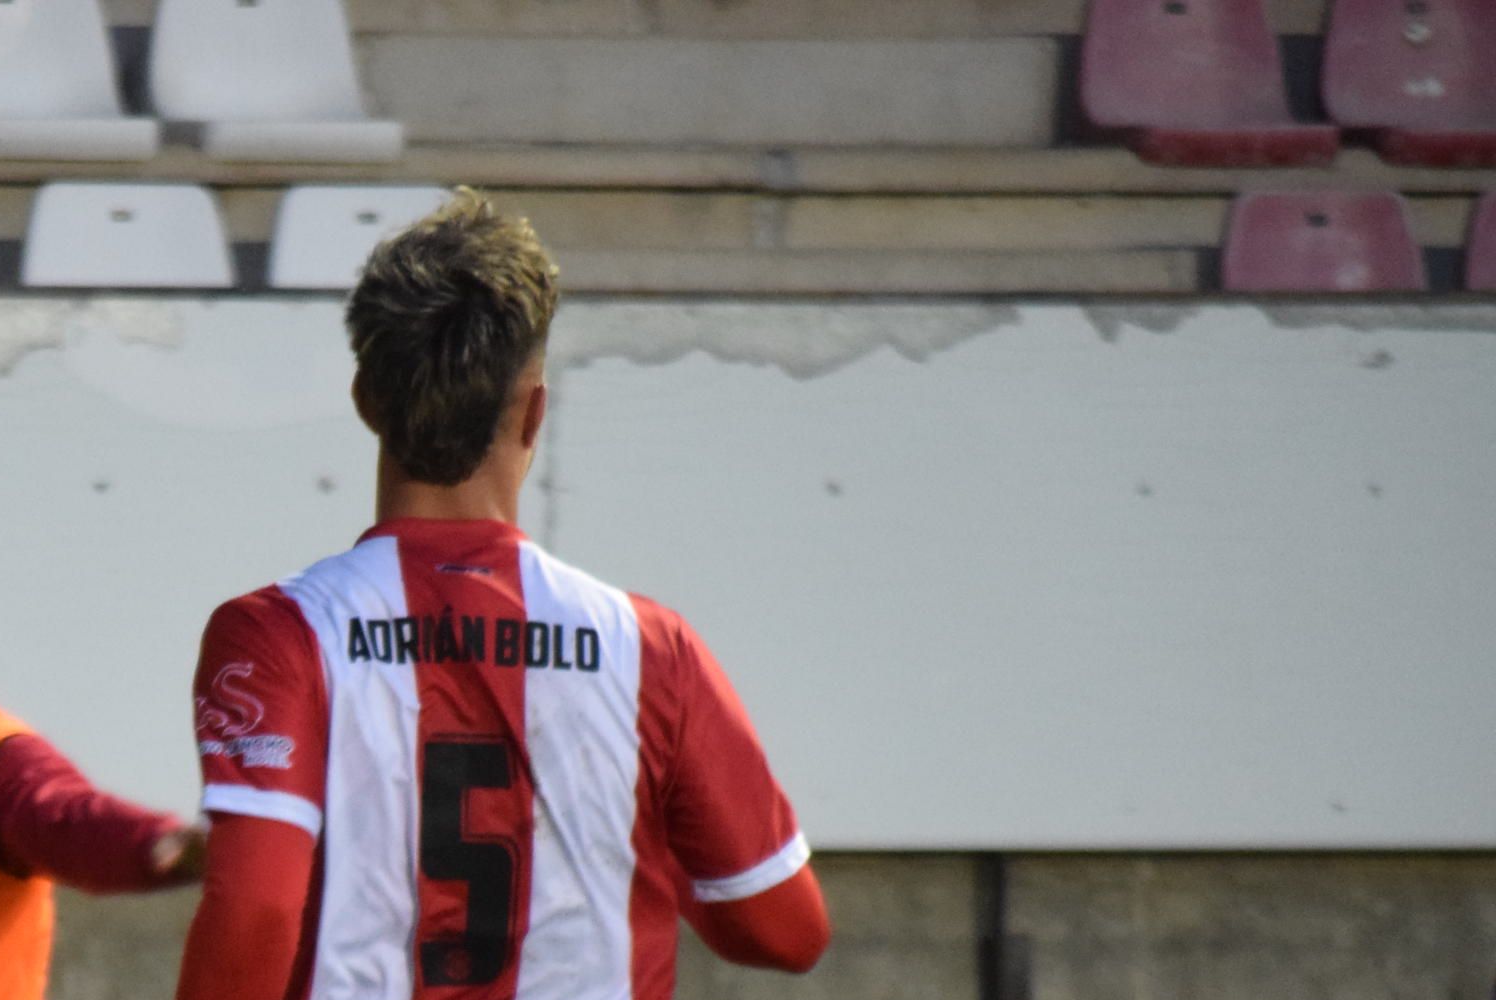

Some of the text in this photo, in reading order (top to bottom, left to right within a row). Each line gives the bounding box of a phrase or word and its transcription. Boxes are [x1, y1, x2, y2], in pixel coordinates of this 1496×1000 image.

[348, 604, 601, 672] ADRIÁN BOLO
[419, 733, 523, 987] 5
